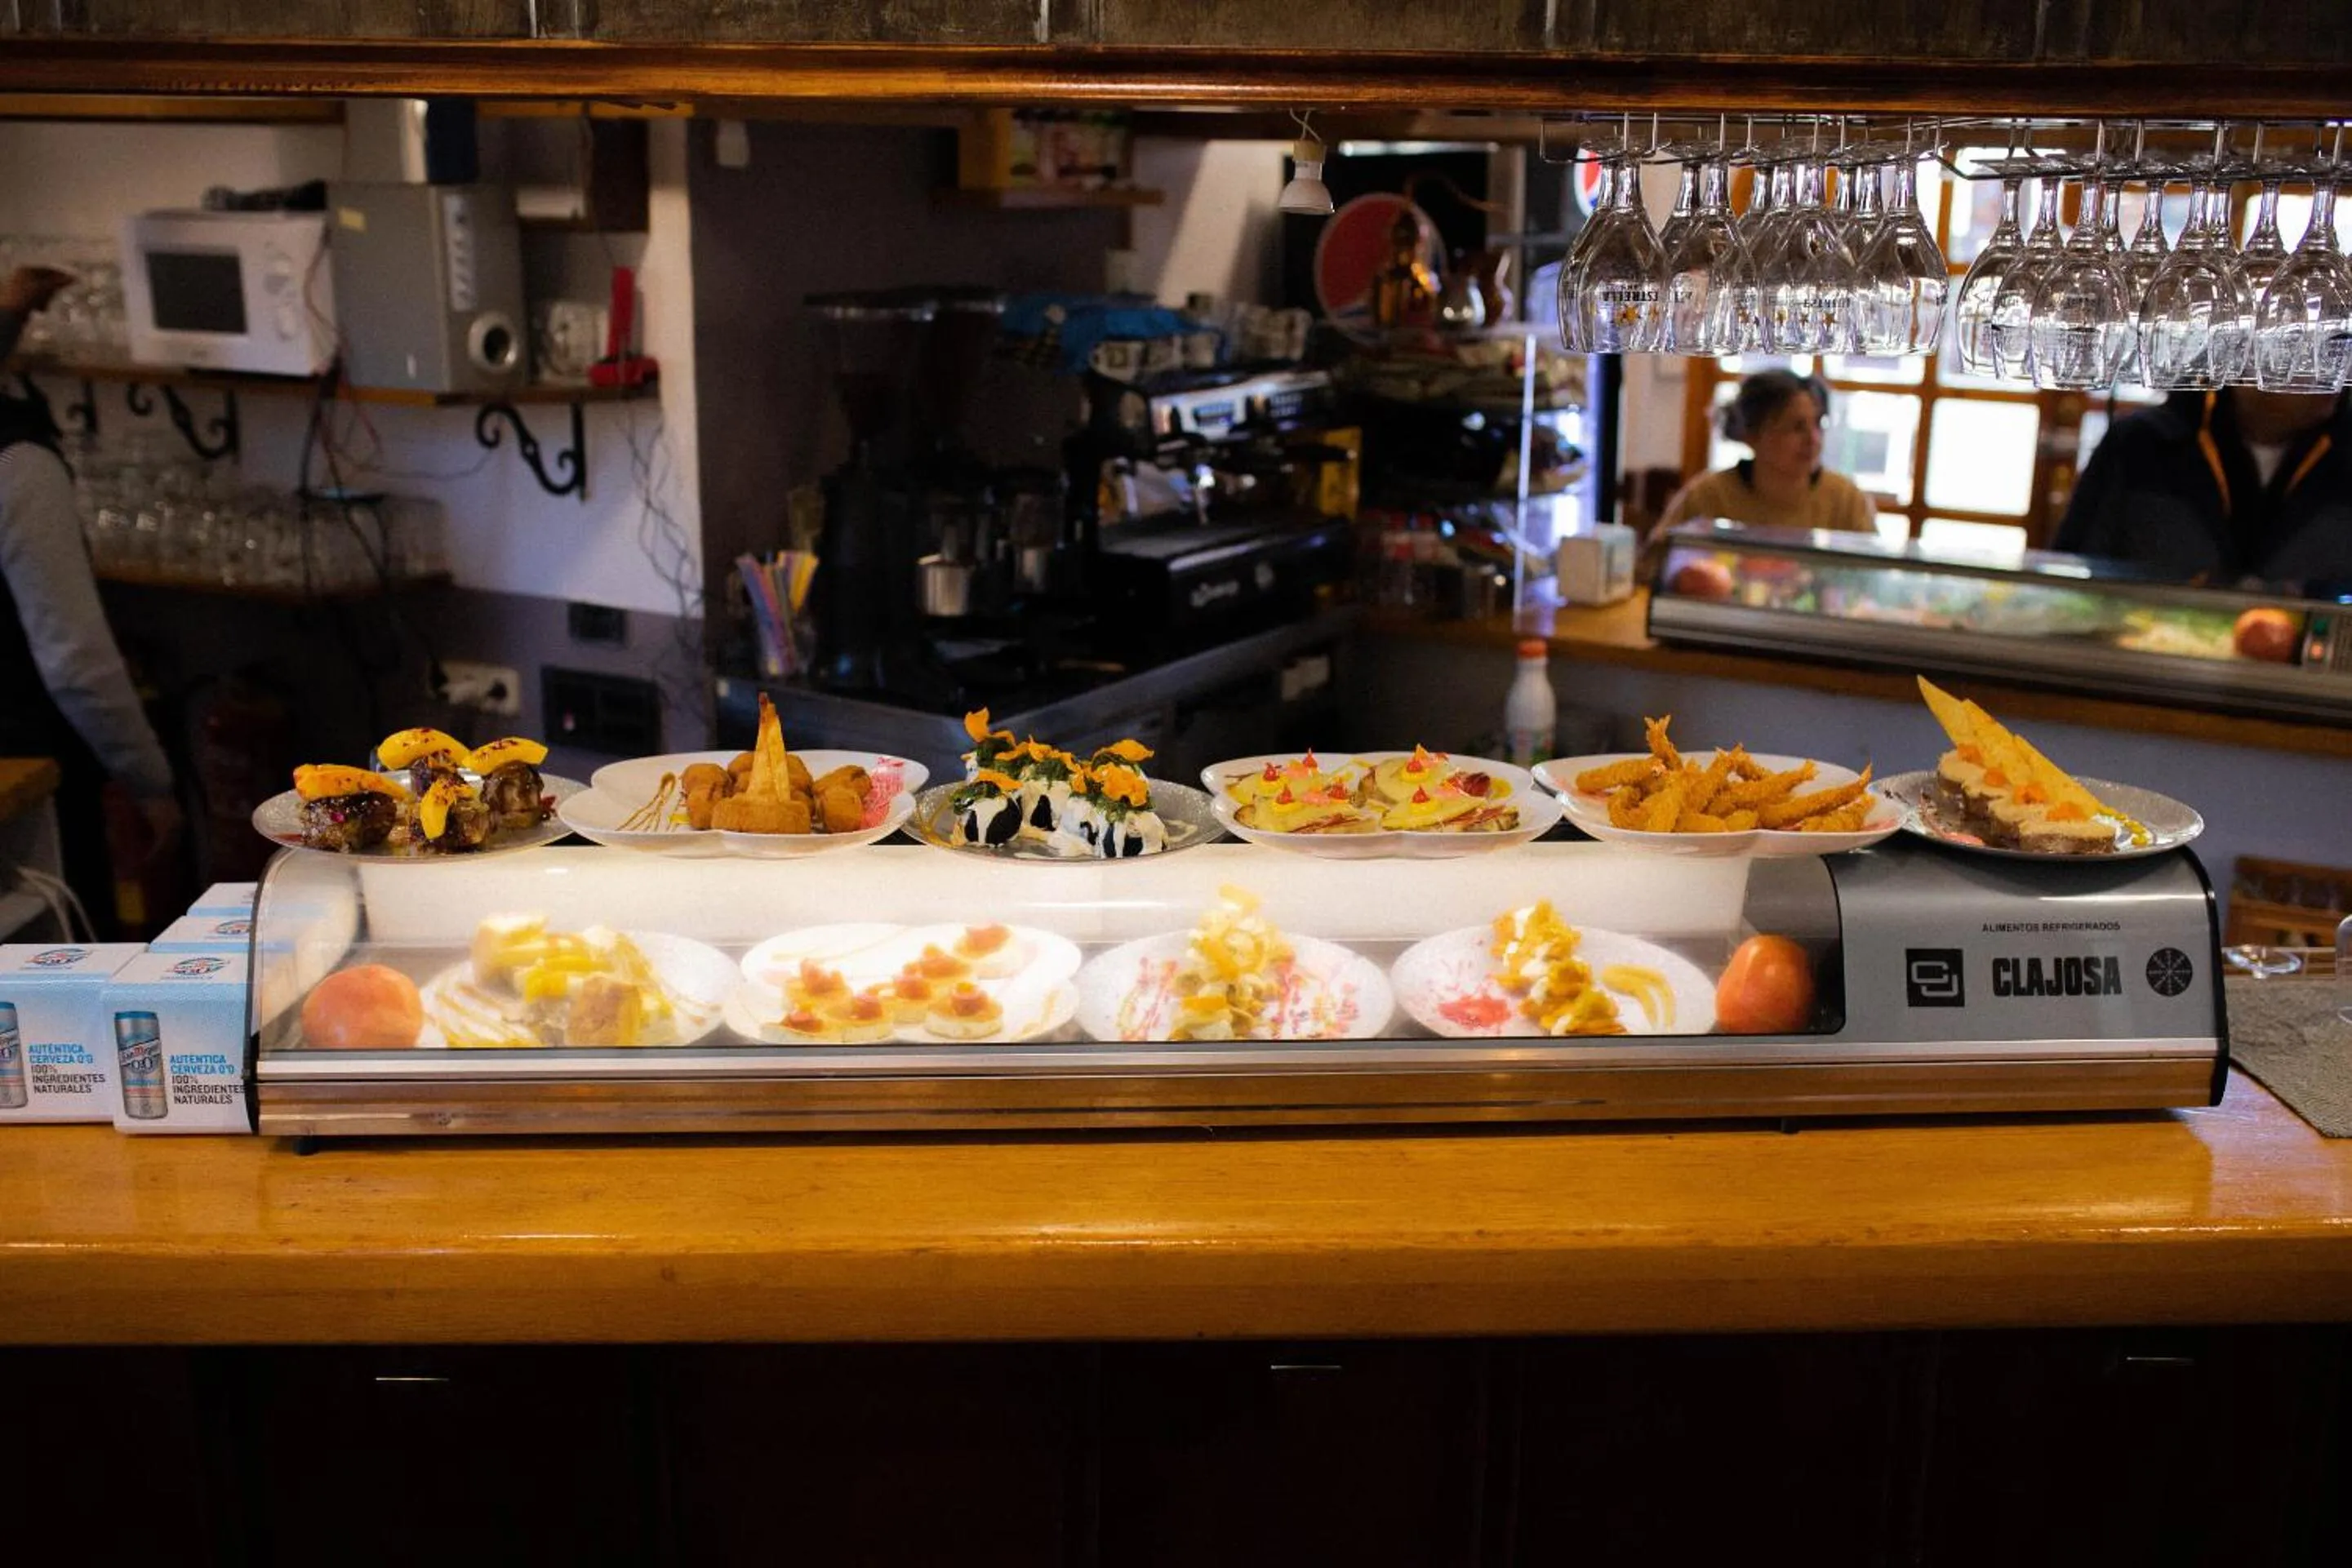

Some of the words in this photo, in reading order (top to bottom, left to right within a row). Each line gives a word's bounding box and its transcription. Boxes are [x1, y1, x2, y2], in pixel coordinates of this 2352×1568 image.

[1602, 291, 1658, 302] ESTRELLA
[1981, 922, 2039, 933] ALIMENTOS
[2043, 921, 2121, 932] REFRIGERADOS
[1992, 956, 2122, 997] CLAJOSA
[29, 1055, 75, 1064] CERVEZA
[31, 1064, 58, 1073] 100%
[171, 1064, 216, 1074] CERVEZA
[33, 1073, 105, 1083] INGREDIENTES
[172, 1075, 198, 1084] 100%
[34, 1084, 92, 1094] NATURALES
[174, 1094, 233, 1104] NATURALES
